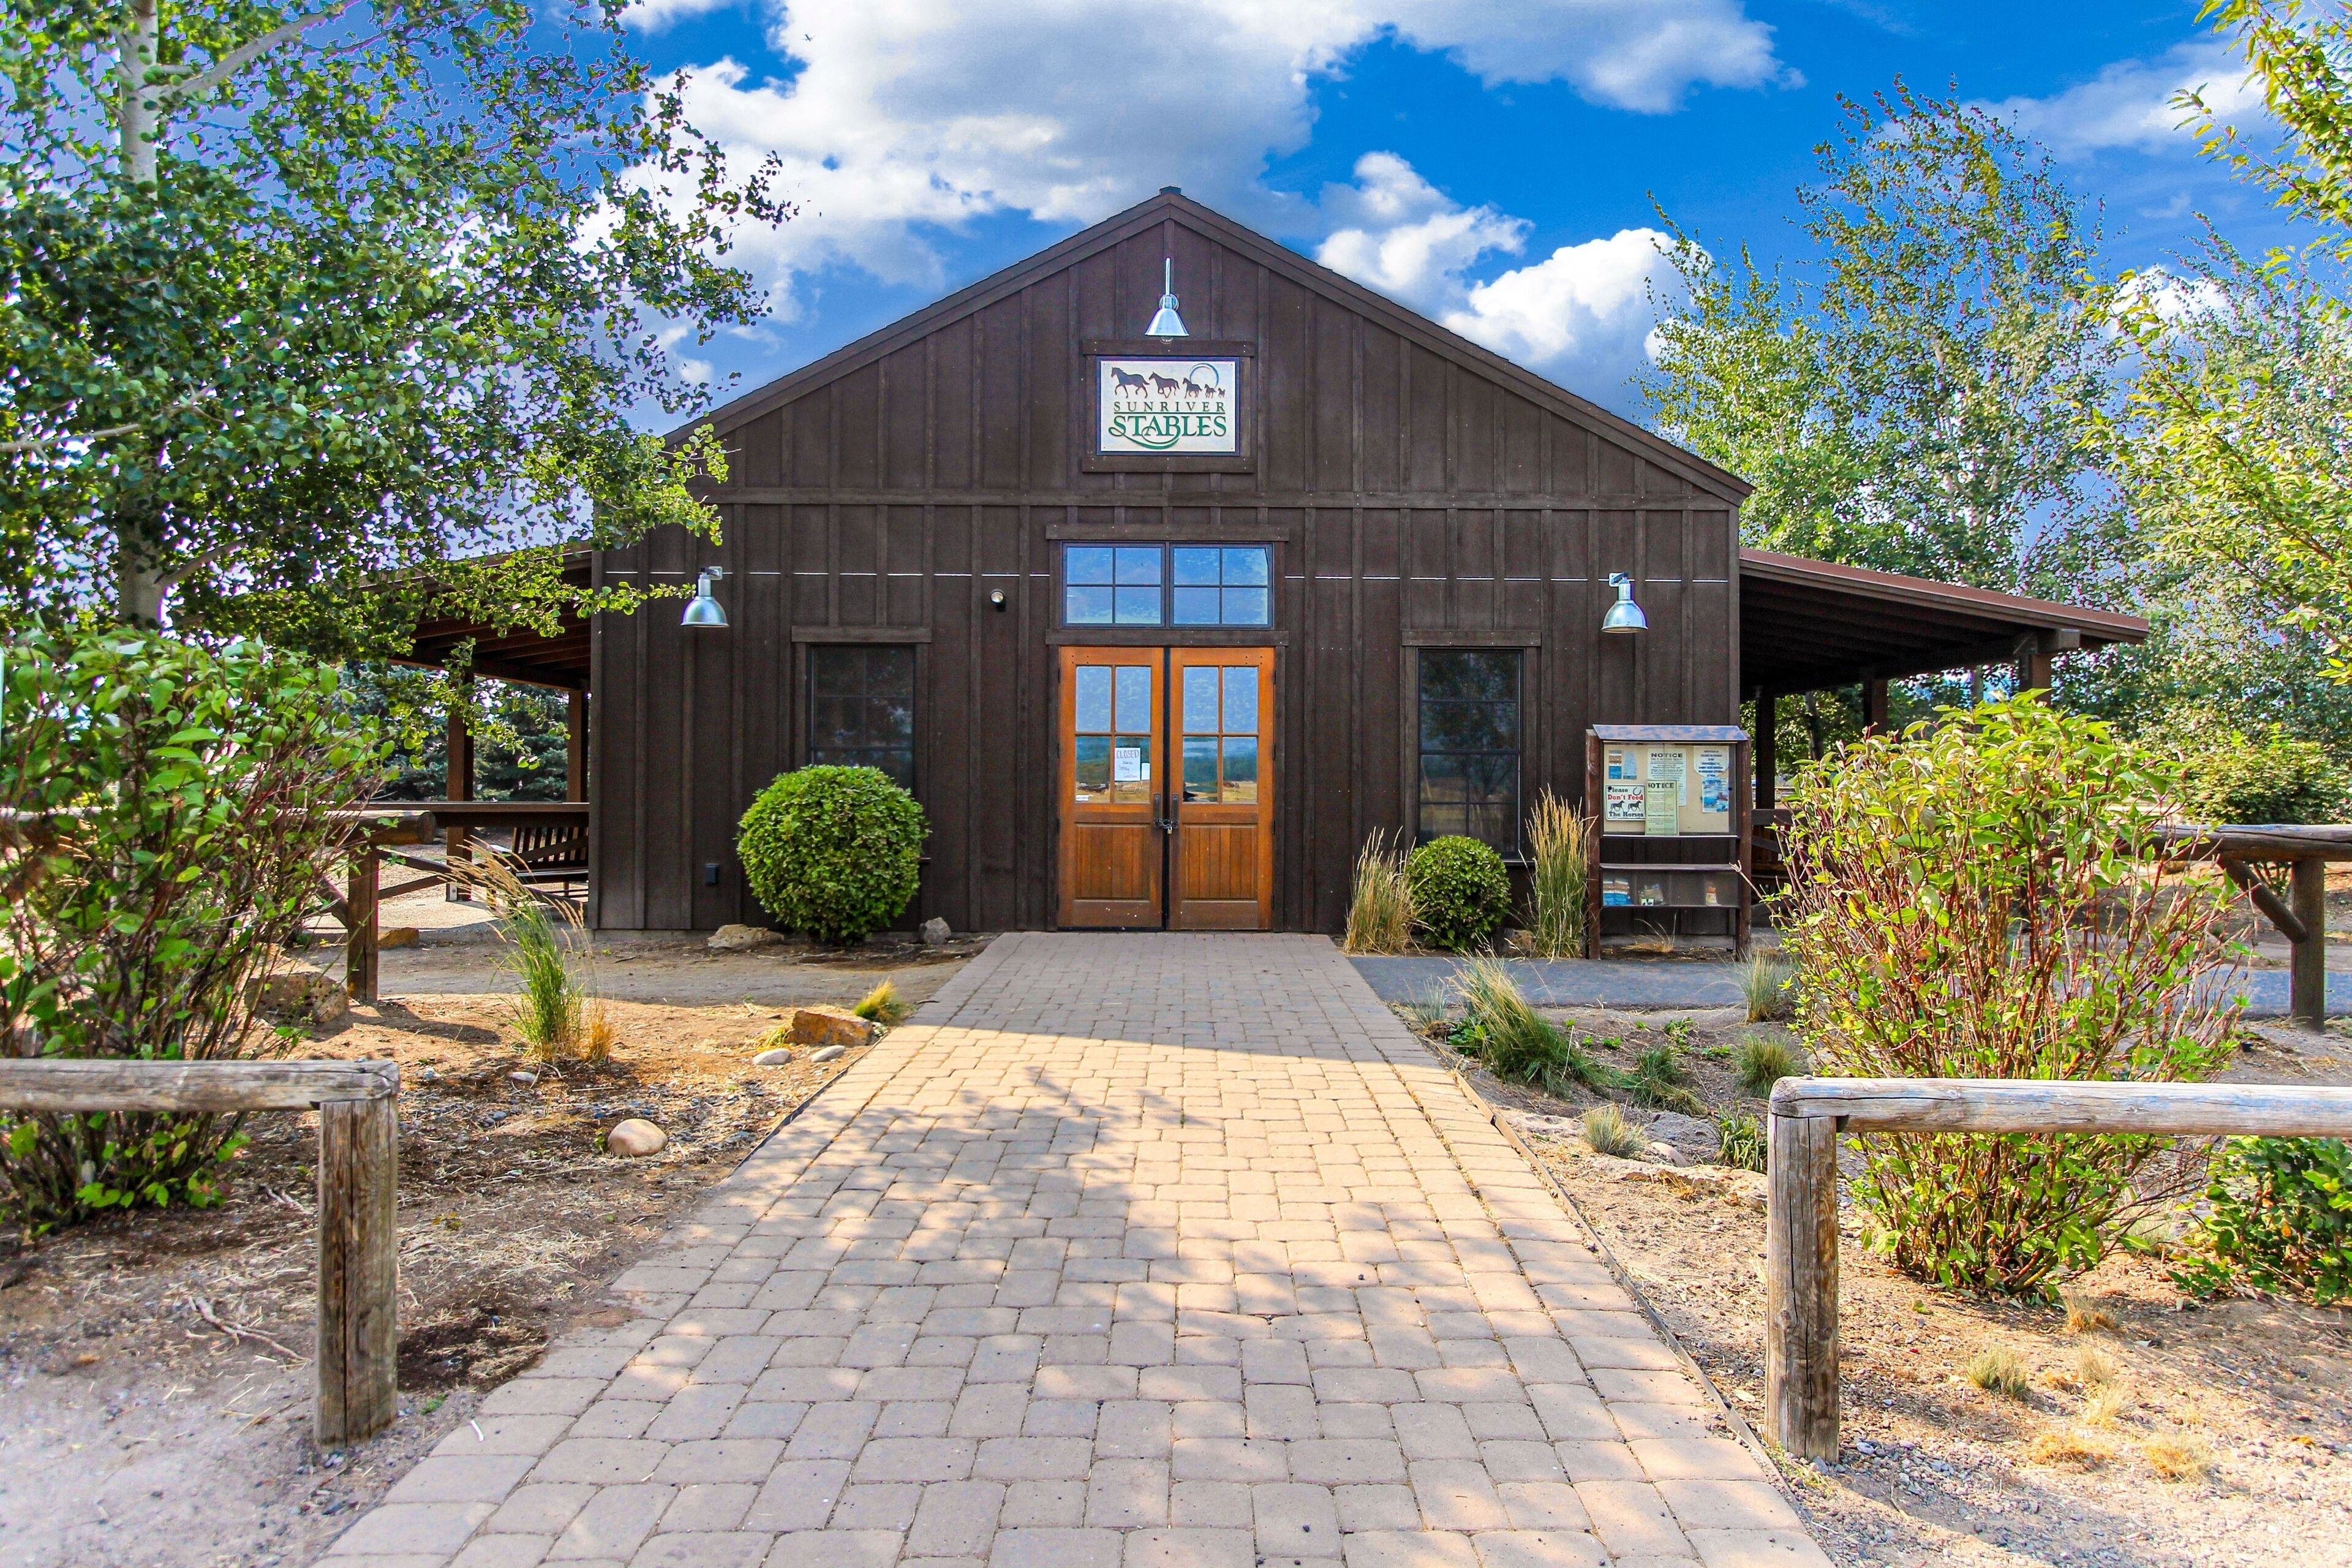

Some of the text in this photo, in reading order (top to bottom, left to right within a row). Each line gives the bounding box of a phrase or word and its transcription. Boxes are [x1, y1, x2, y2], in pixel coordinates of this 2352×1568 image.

[1114, 401, 1225, 412] SUNRIVER
[1109, 415, 1226, 450] STABLES
[1116, 750, 1139, 758] CLOSED
